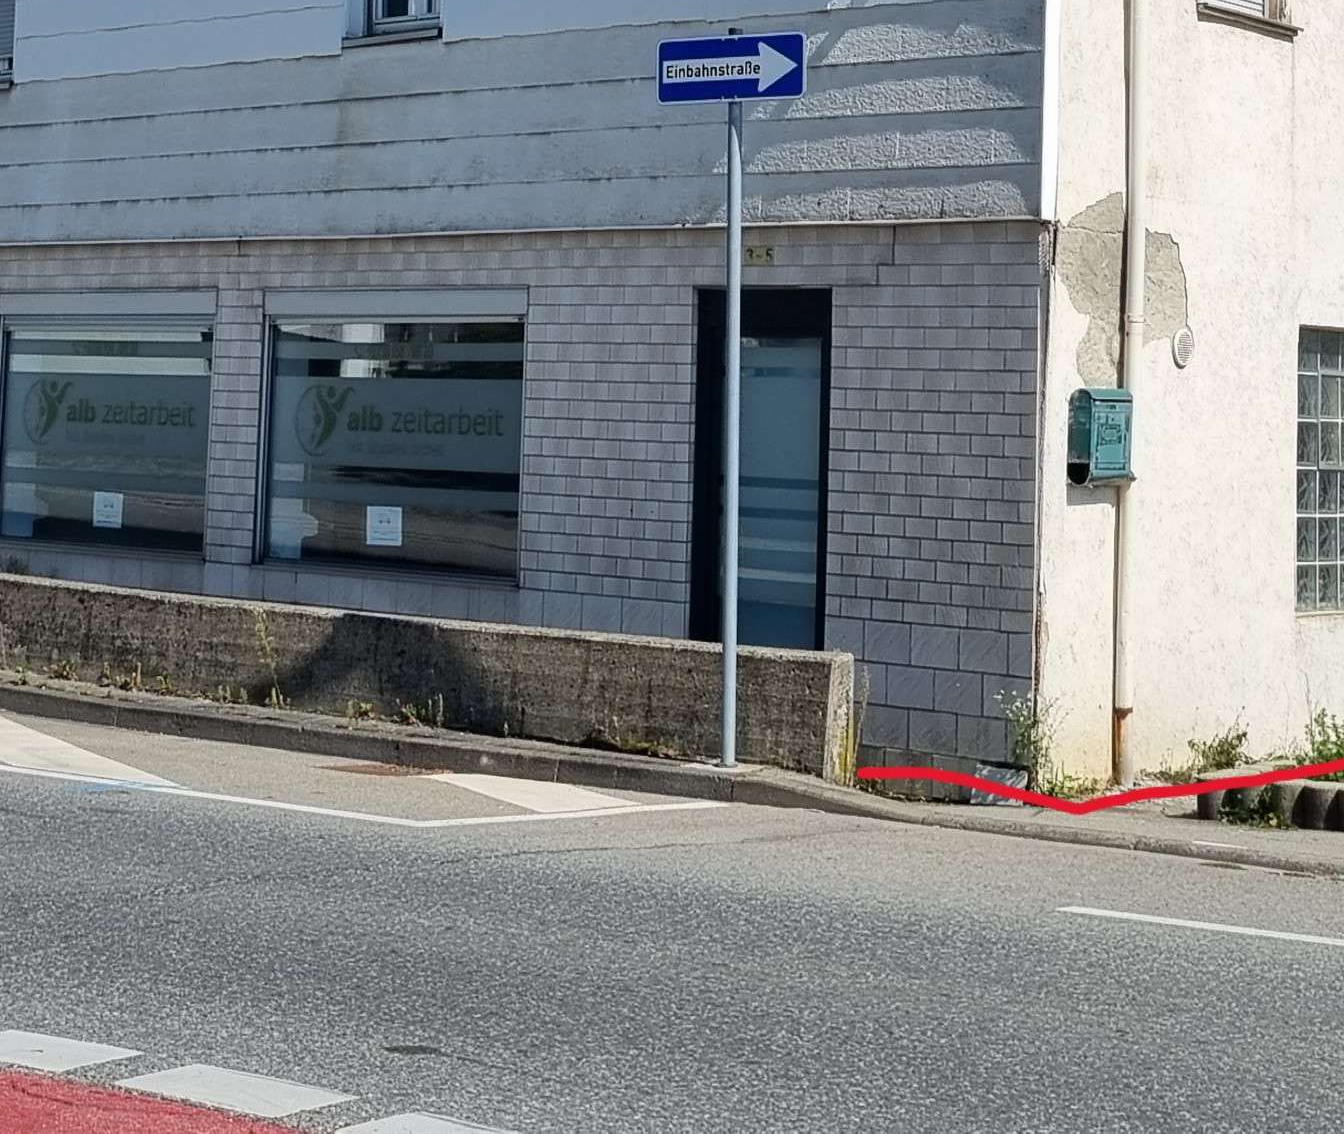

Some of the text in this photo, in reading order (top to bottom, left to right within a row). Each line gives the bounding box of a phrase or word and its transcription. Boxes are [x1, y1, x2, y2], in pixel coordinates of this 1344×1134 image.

[666, 61, 760, 79] Einbahnstraße
[66, 398, 196, 427] alb zeitarbeit
[347, 405, 505, 437] alb zeitarbeit
